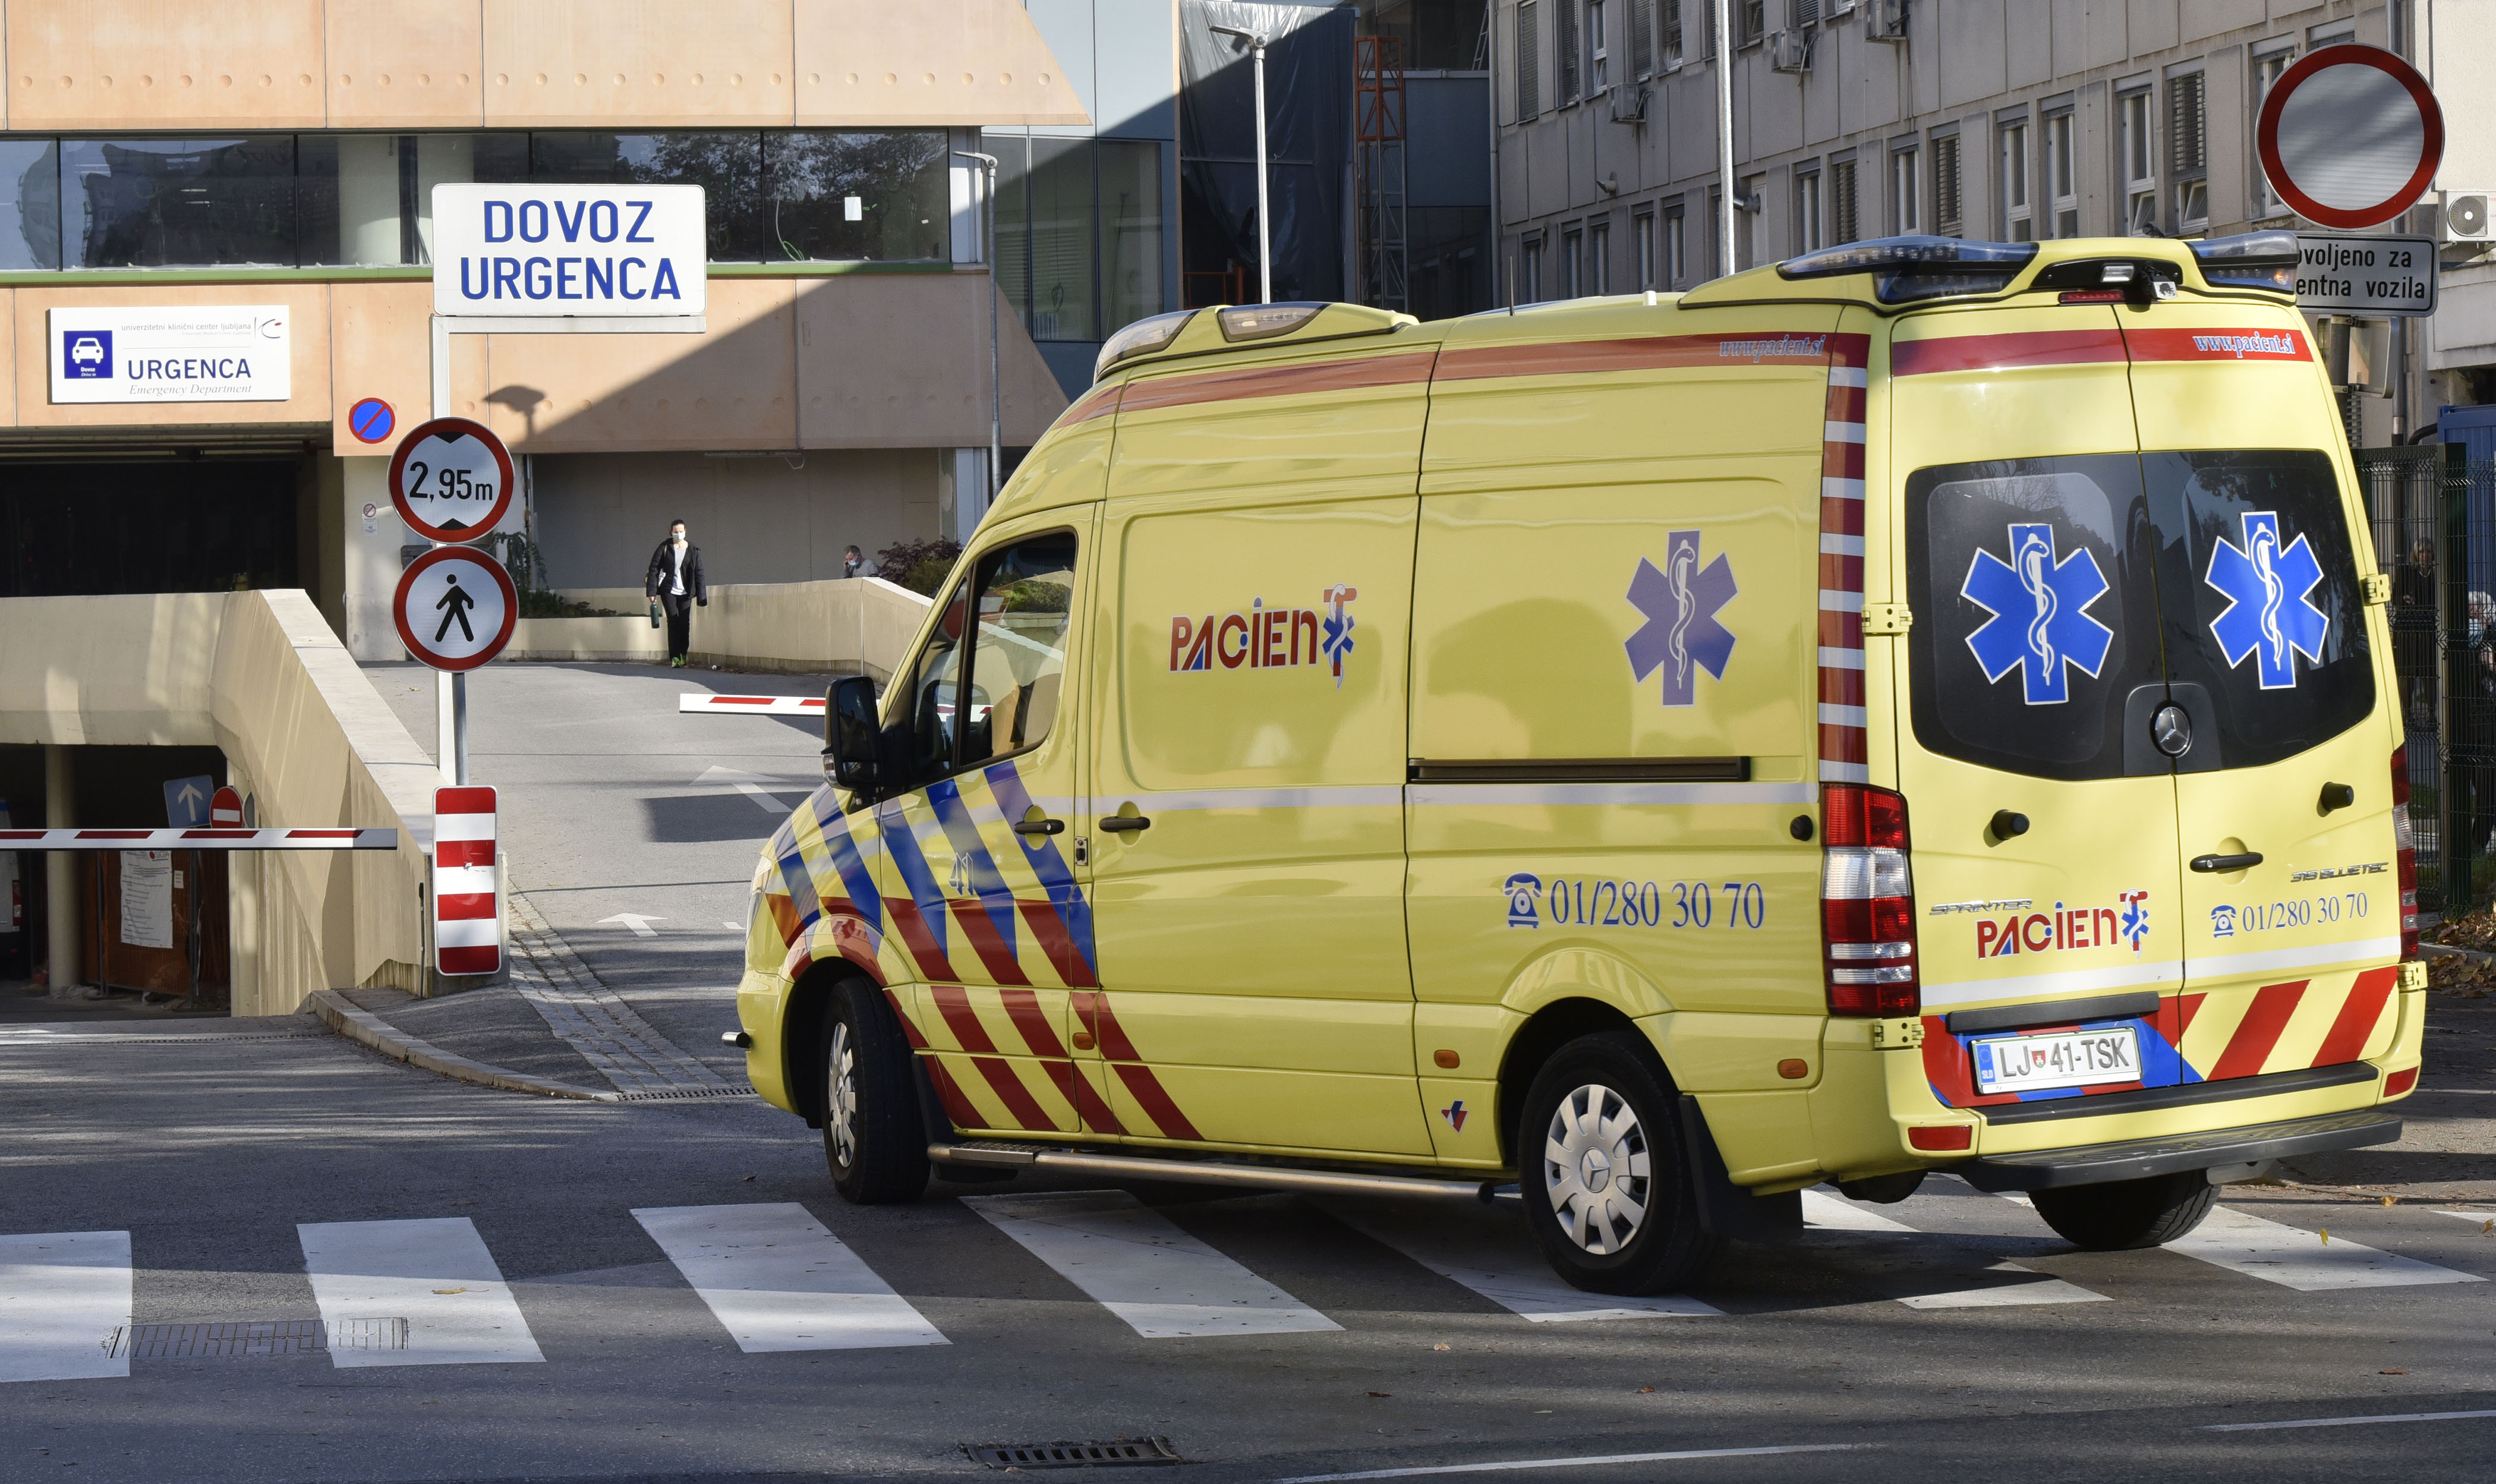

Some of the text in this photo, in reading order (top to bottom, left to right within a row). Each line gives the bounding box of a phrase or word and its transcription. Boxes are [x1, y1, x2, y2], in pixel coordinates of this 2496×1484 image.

[484, 200, 654, 243] DOVOZ
[2388, 251, 2412, 267] za
[461, 256, 681, 300] URGENCA
[2296, 274, 2425, 298] entna vozila
[220, 323, 251, 332] ljubljana
[1719, 334, 1826, 363] www.pacient.si
[2192, 331, 2296, 358] www.pacient.si
[128, 358, 251, 380] URGENCA
[130, 384, 252, 397] Emergency Department
[948, 852, 975, 897] 41
[2319, 862, 2389, 880] BLUETEC
[1550, 879, 1764, 929] 01/280 30 70
[1930, 898, 2033, 916] SPRINTER
[2242, 892, 2368, 932] 01/280 30 70
[1999, 1044, 2031, 1077] LJ
[1981, 1069, 1994, 1080] SLO
